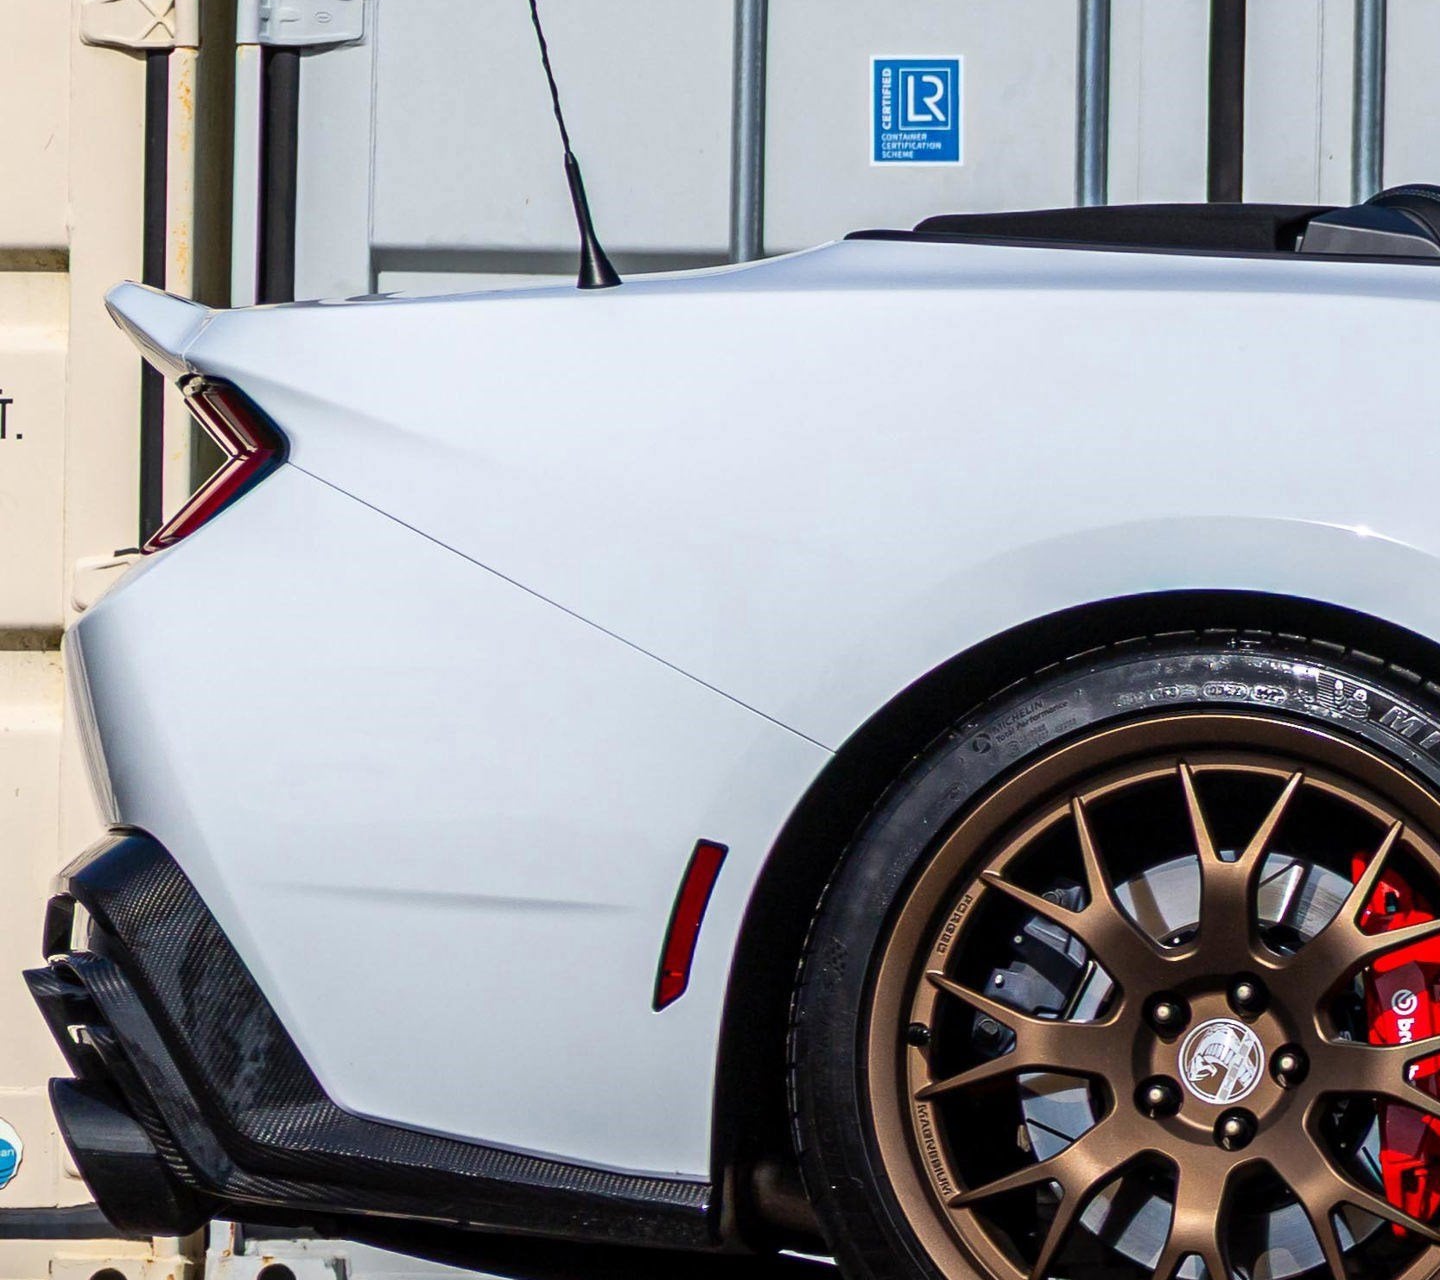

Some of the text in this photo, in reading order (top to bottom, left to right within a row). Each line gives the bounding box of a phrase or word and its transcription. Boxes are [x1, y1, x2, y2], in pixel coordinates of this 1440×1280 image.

[882, 67, 892, 130] CERTIFIED
[906, 75, 947, 122] LR
[992, 700, 1044, 734] MICHELIN
[936, 894, 973, 954] FORGED
